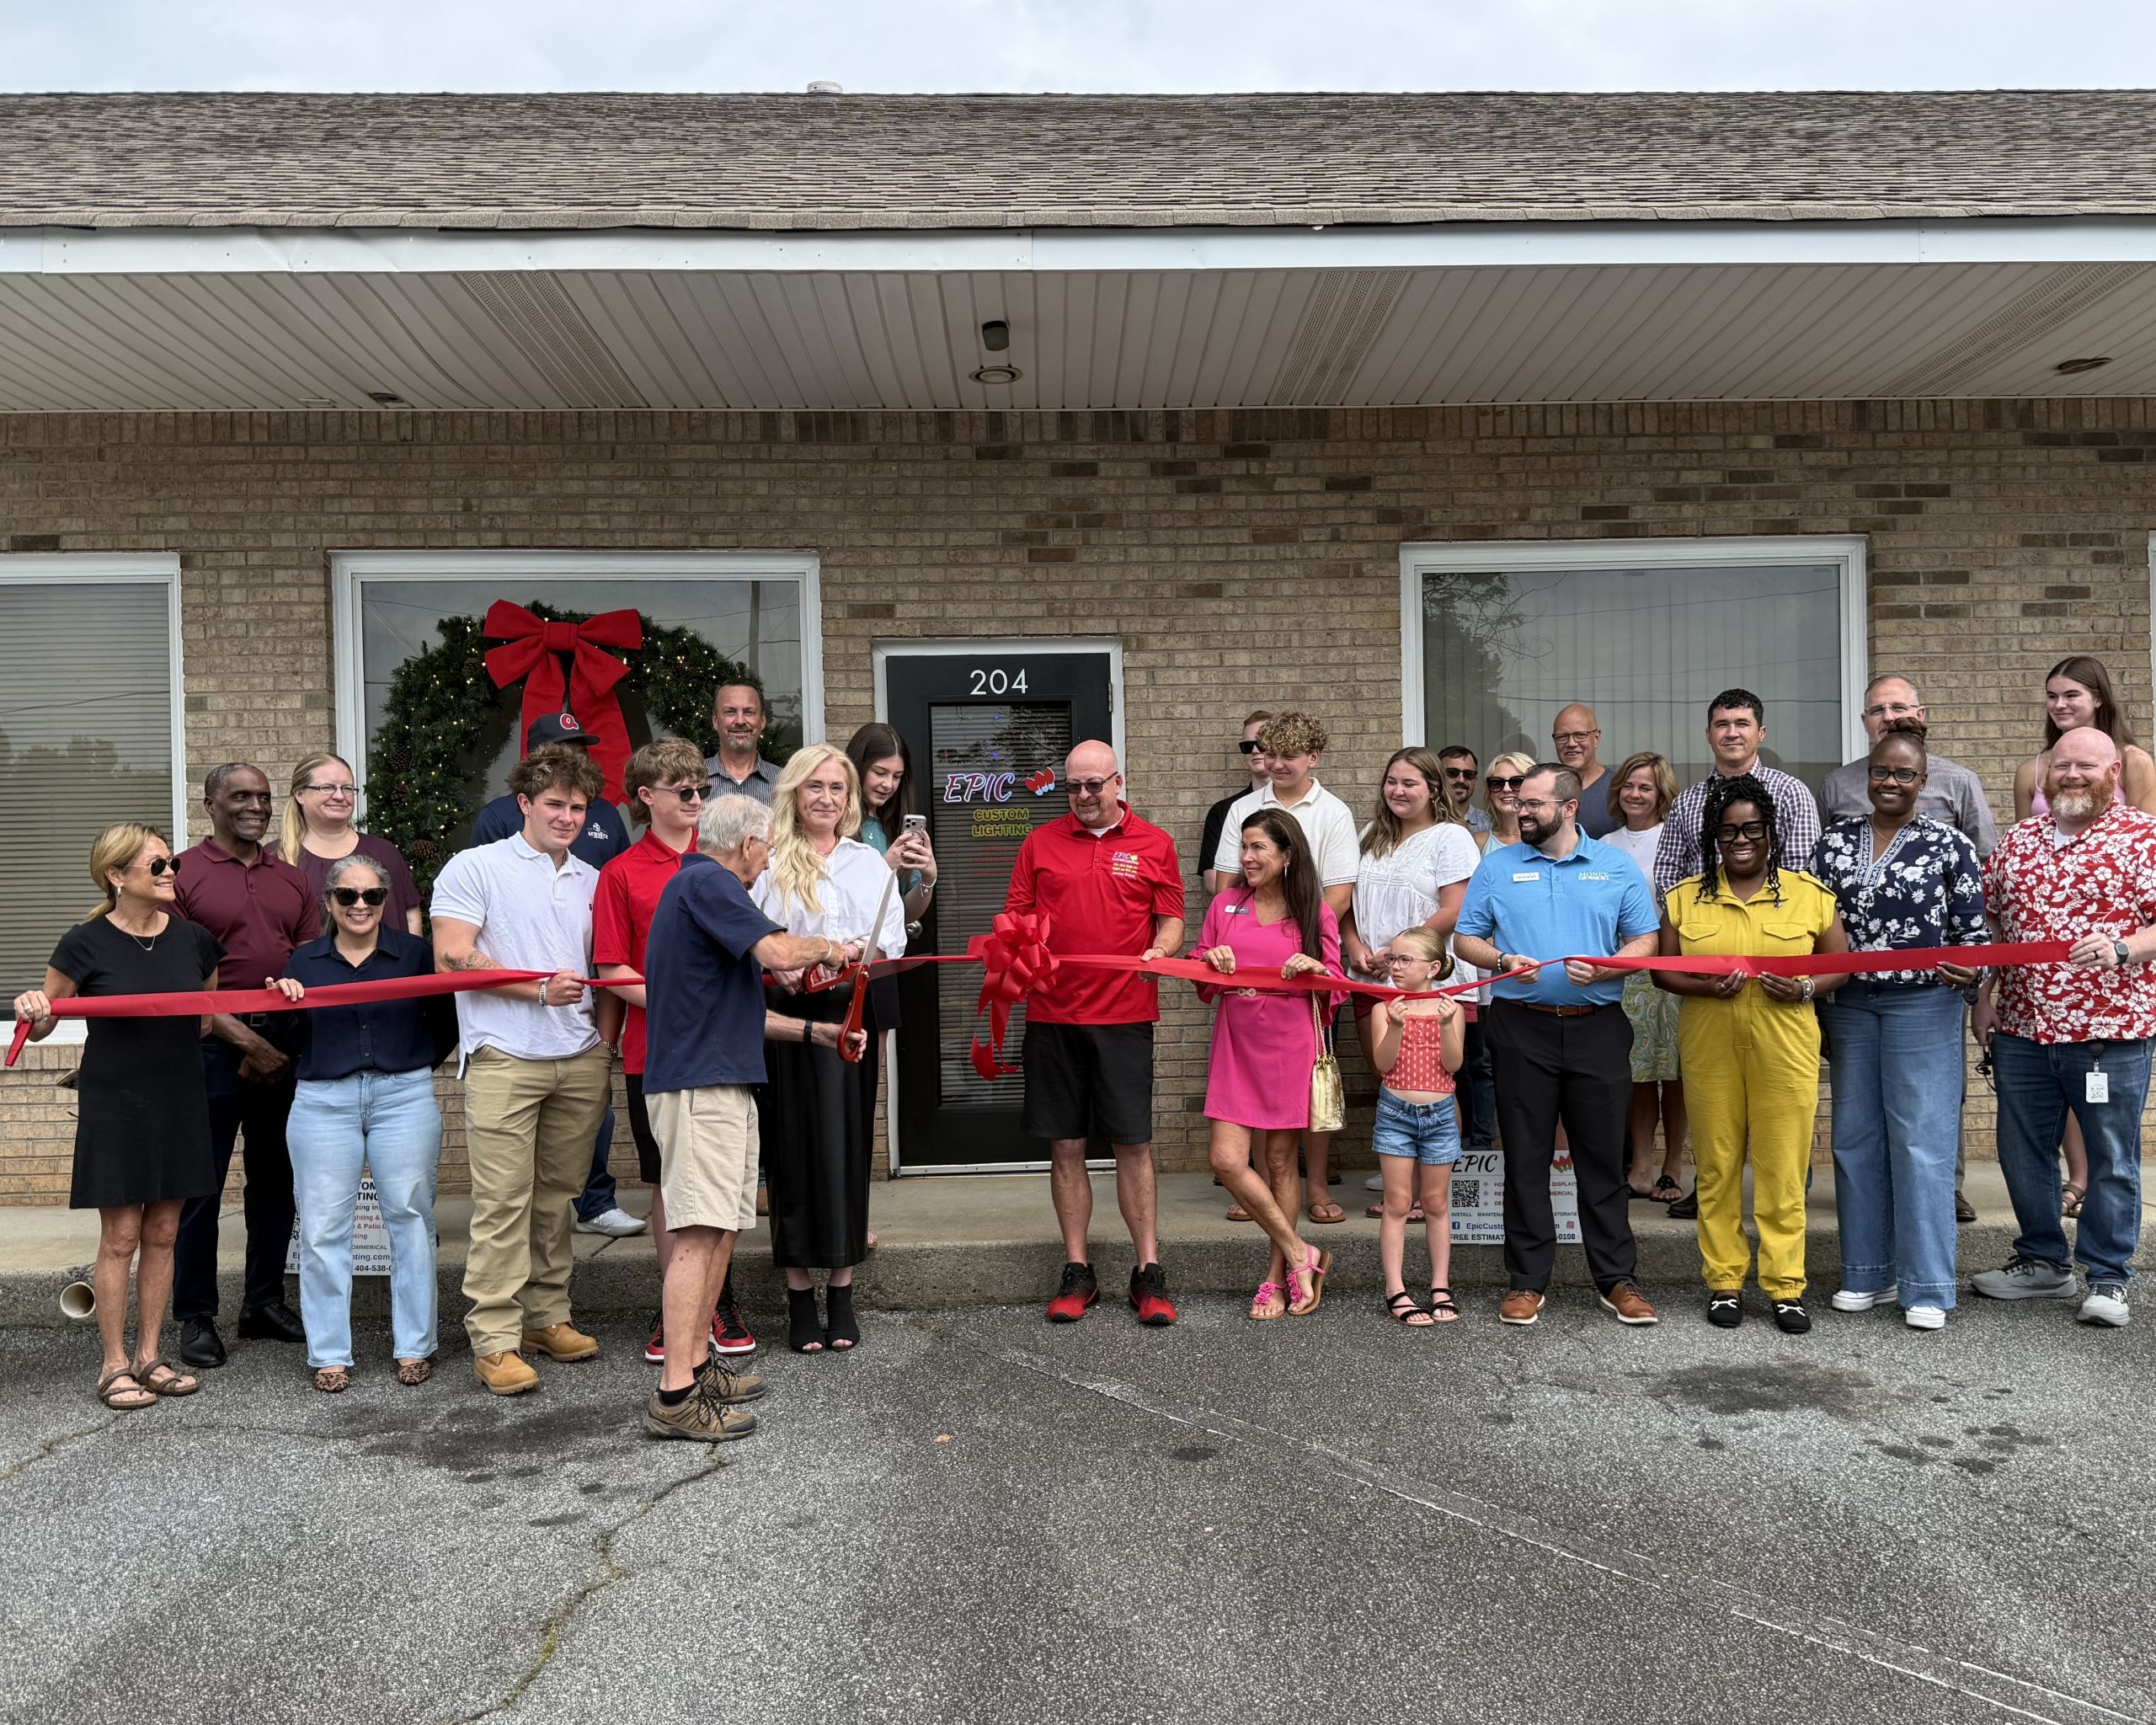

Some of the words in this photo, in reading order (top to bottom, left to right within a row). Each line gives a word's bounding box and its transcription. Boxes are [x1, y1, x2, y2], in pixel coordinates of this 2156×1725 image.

[969, 668, 1028, 695] 204
[943, 772, 1016, 803] EPIC
[973, 809, 1029, 821] CUSTOM
[971, 824, 1033, 837] LIGHTING
[1451, 1154, 1498, 1172] EPIC
